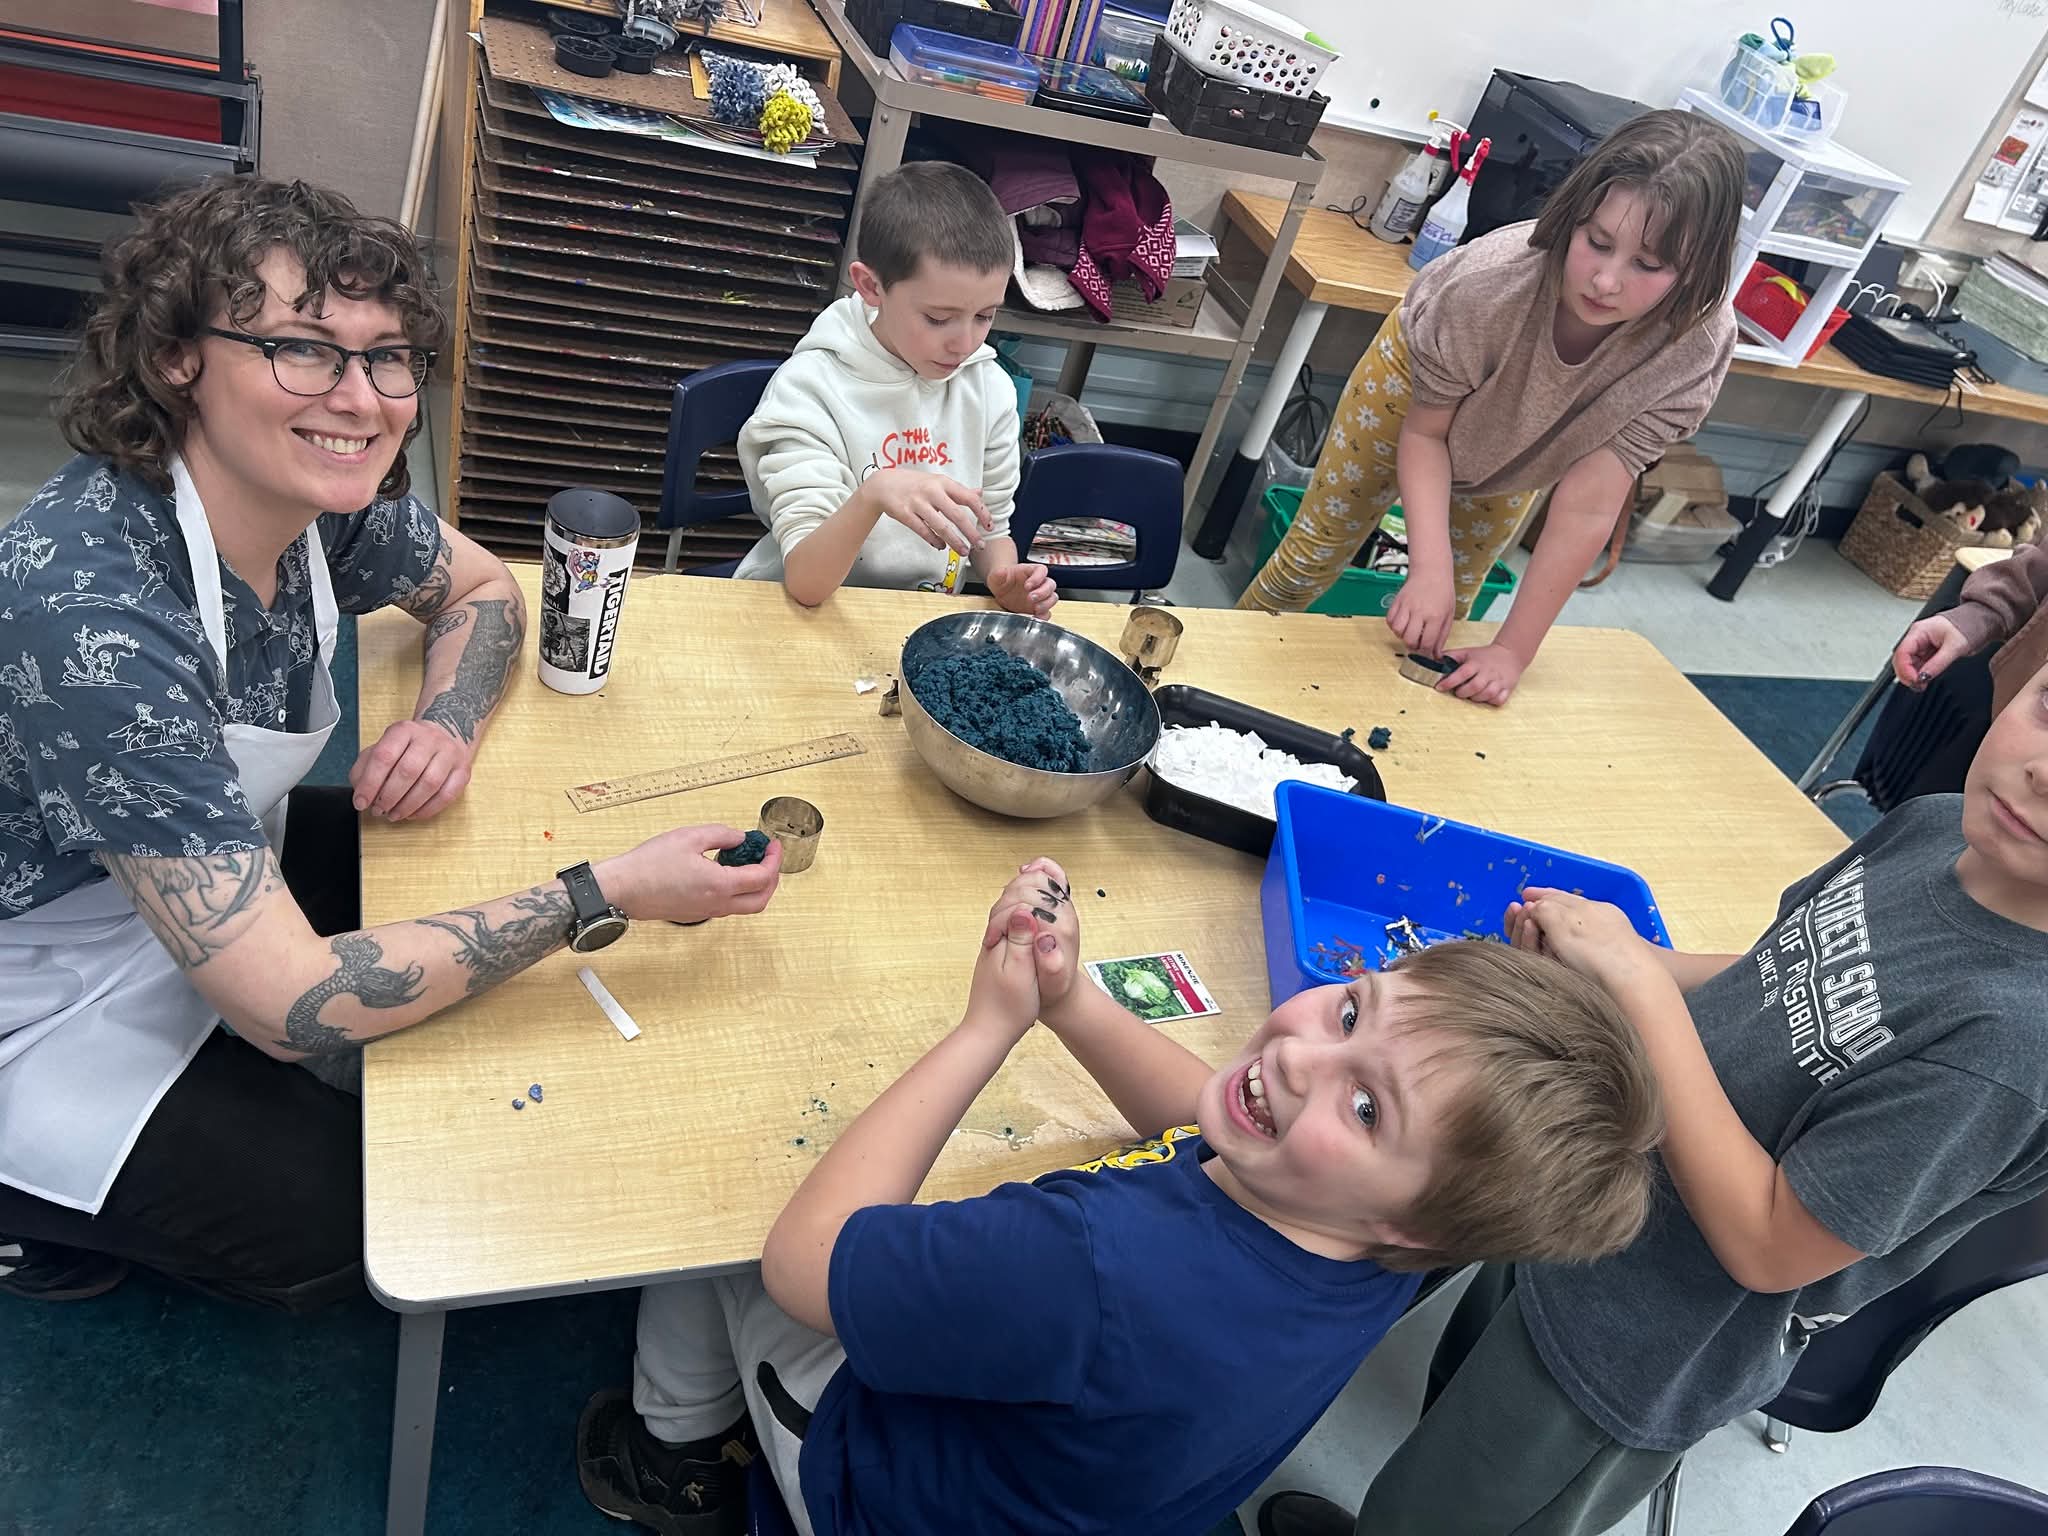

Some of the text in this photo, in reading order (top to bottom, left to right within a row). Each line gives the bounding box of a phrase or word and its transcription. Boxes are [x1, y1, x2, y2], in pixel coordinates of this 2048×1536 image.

[902, 428, 930, 444] THE
[594, 571, 625, 675] TIGERTAIL
[1779, 927, 1805, 954] OF
[1815, 883, 1870, 968] STREET
[1756, 948, 1780, 1012] SINCE 19
